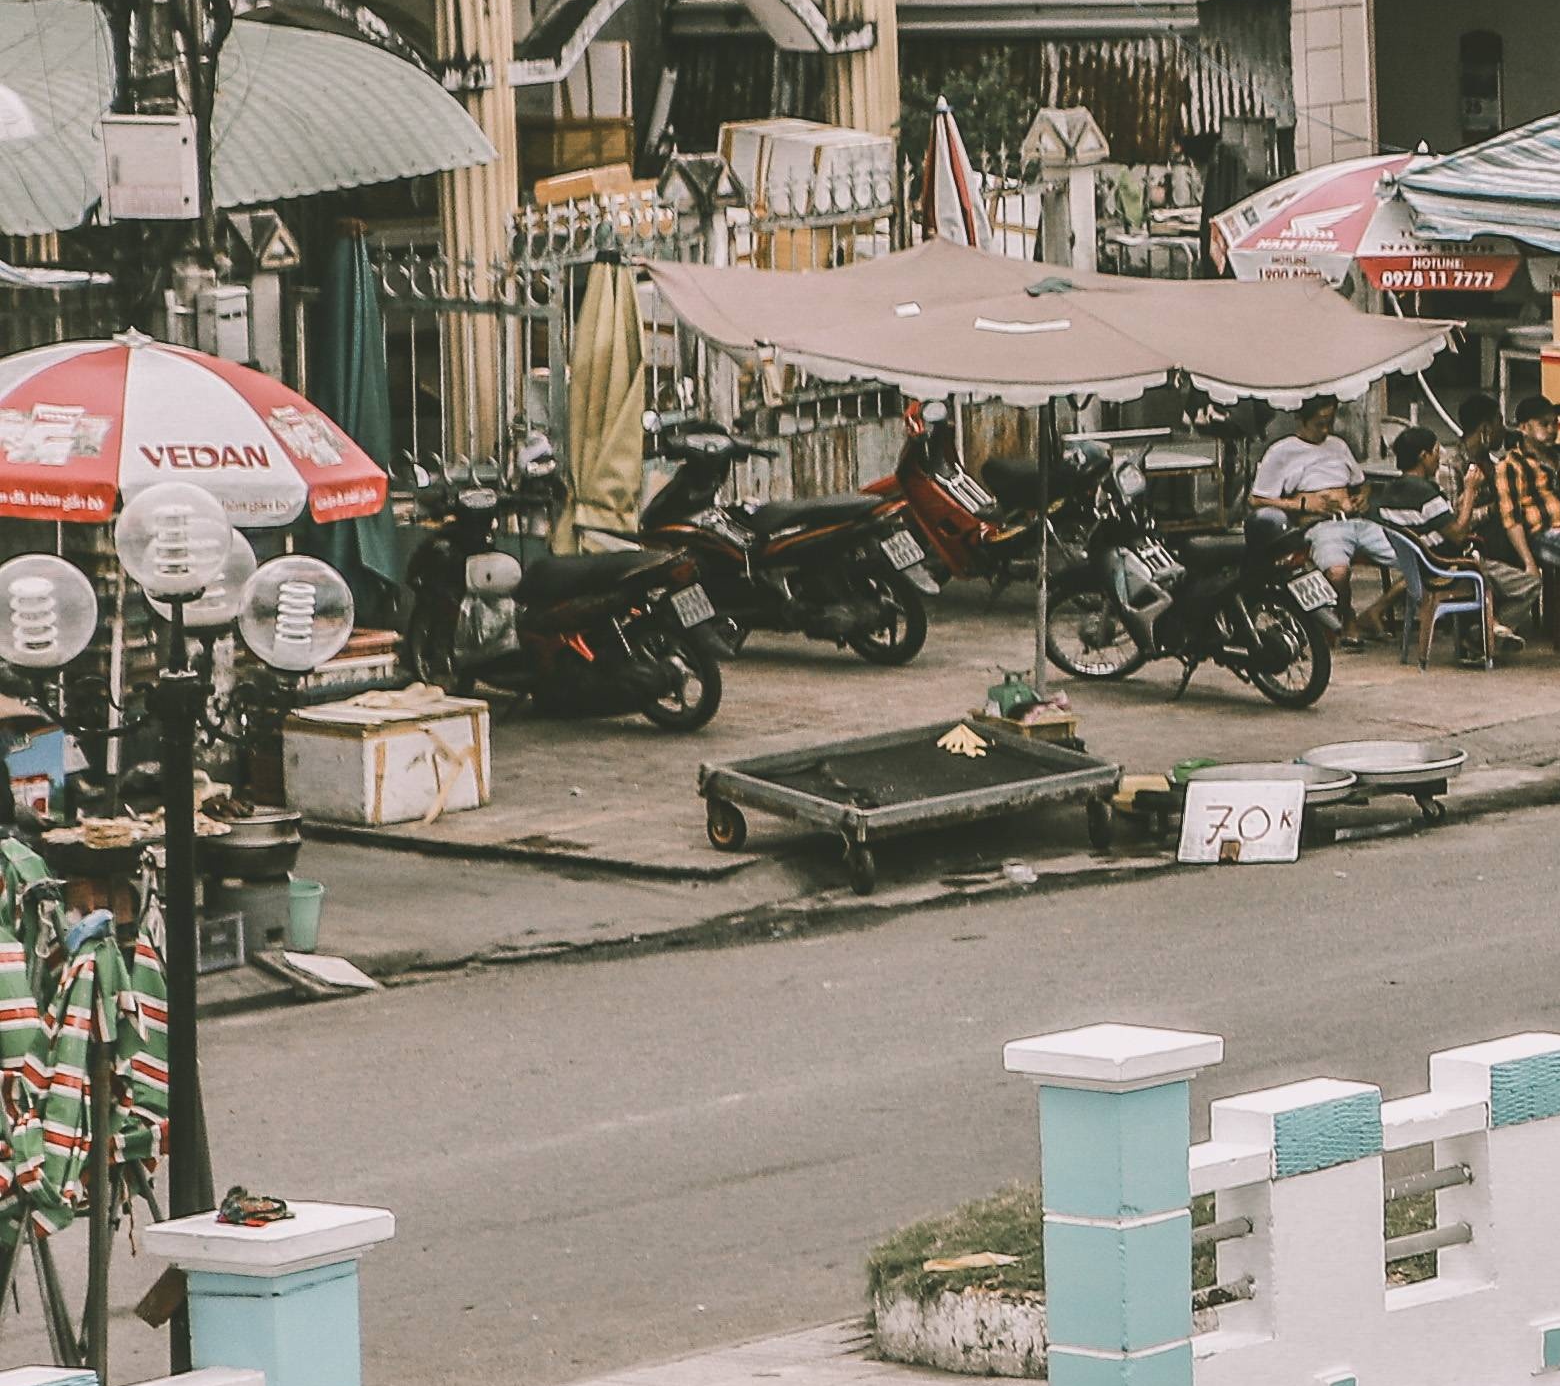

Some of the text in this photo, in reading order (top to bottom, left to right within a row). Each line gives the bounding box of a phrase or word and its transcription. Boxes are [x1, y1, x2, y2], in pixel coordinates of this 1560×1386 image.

[1412, 257, 1465, 270] HOTLINE:
[1381, 270, 1494, 289] 0978 11 7777
[138, 443, 272, 470] VEDAN
